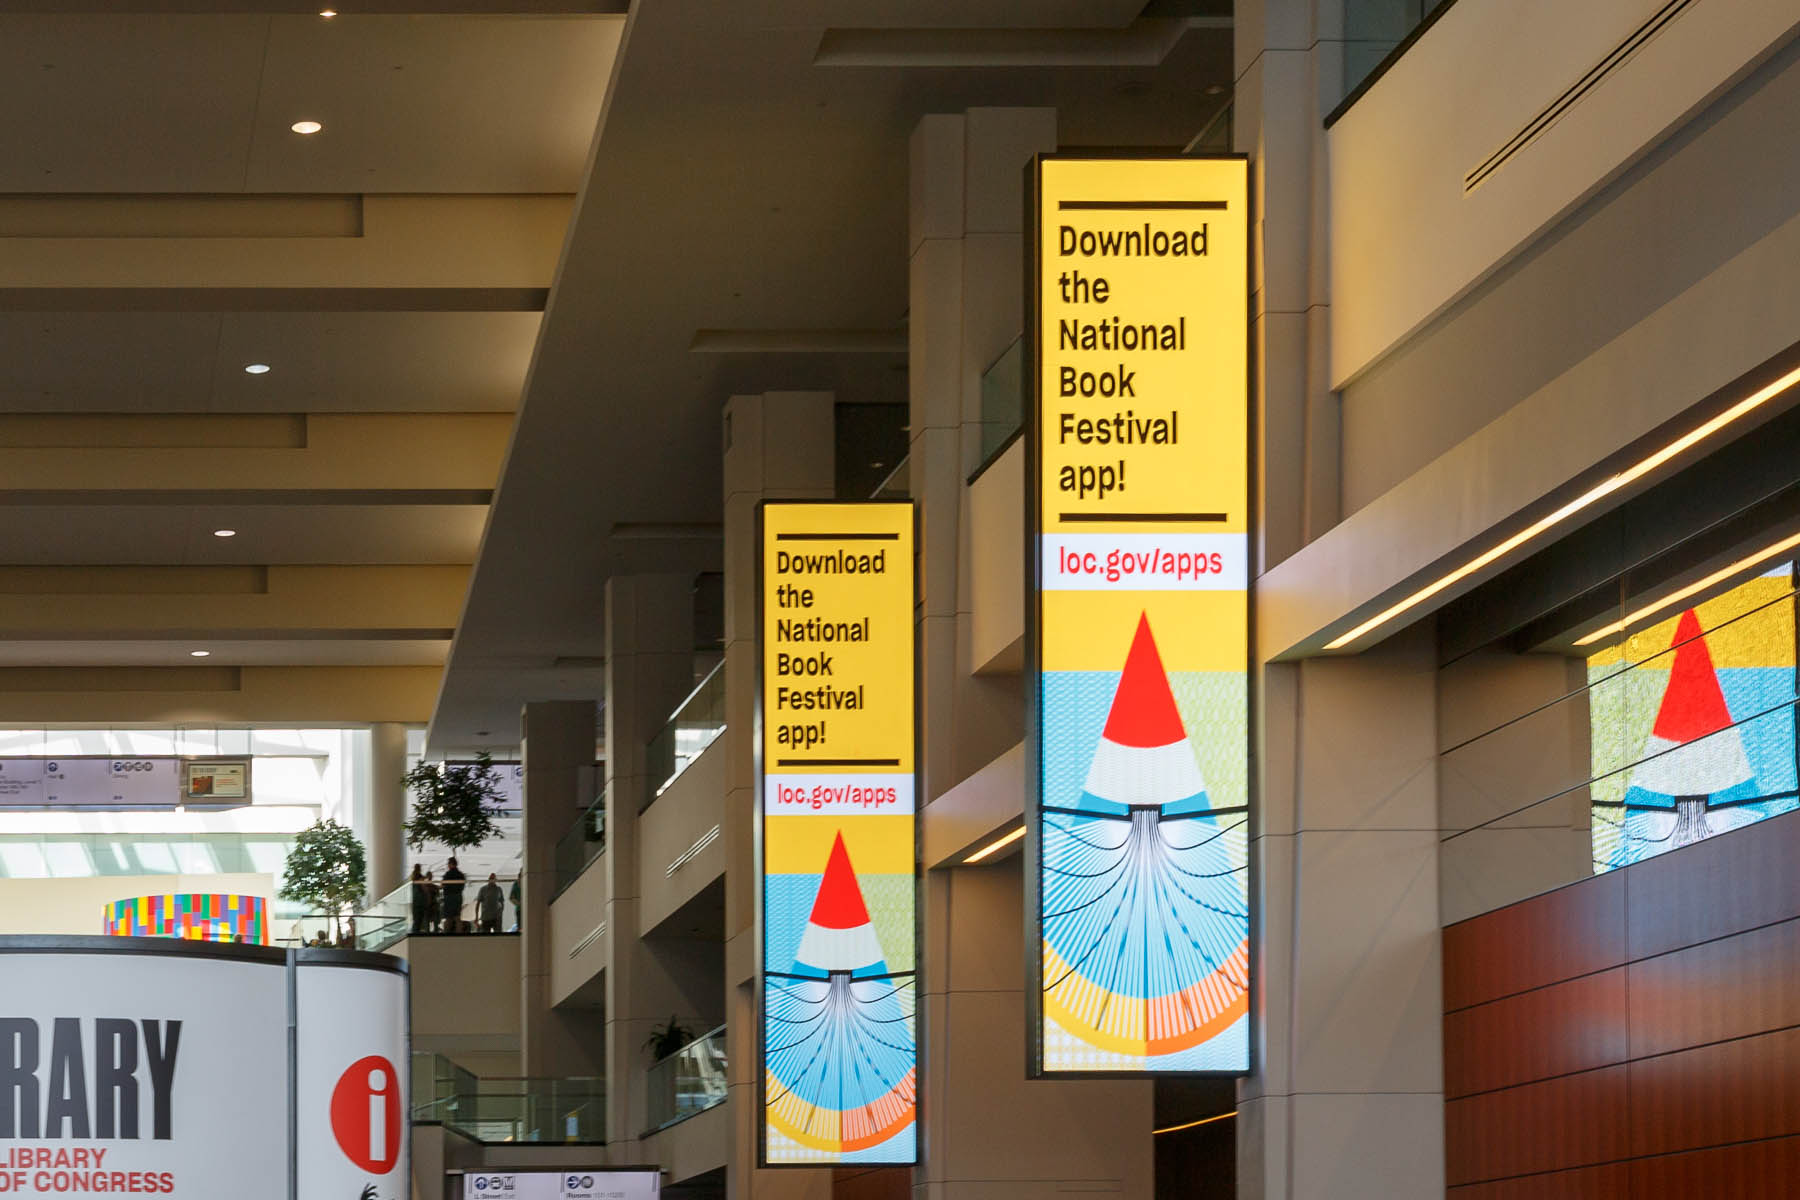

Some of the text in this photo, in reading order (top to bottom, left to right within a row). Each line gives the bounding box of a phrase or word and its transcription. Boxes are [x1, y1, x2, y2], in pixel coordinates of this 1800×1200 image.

[1059, 223, 1207, 257] Download
[1059, 270, 1109, 303] the
[1059, 316, 1184, 351] National
[1059, 364, 1135, 397] Book
[1059, 410, 1177, 445] Festival
[1059, 460, 1124, 499] app!
[777, 549, 884, 574] Download
[1059, 546, 1222, 582] loc.gov/apps
[777, 584, 813, 608] the
[777, 617, 868, 642] National
[777, 652, 832, 676] Book
[777, 685, 863, 710] Festival
[777, 721, 825, 750] app!
[778, 784, 896, 809] loc.gov/apps
[34, 1171, 174, 1193] CONGRESS
